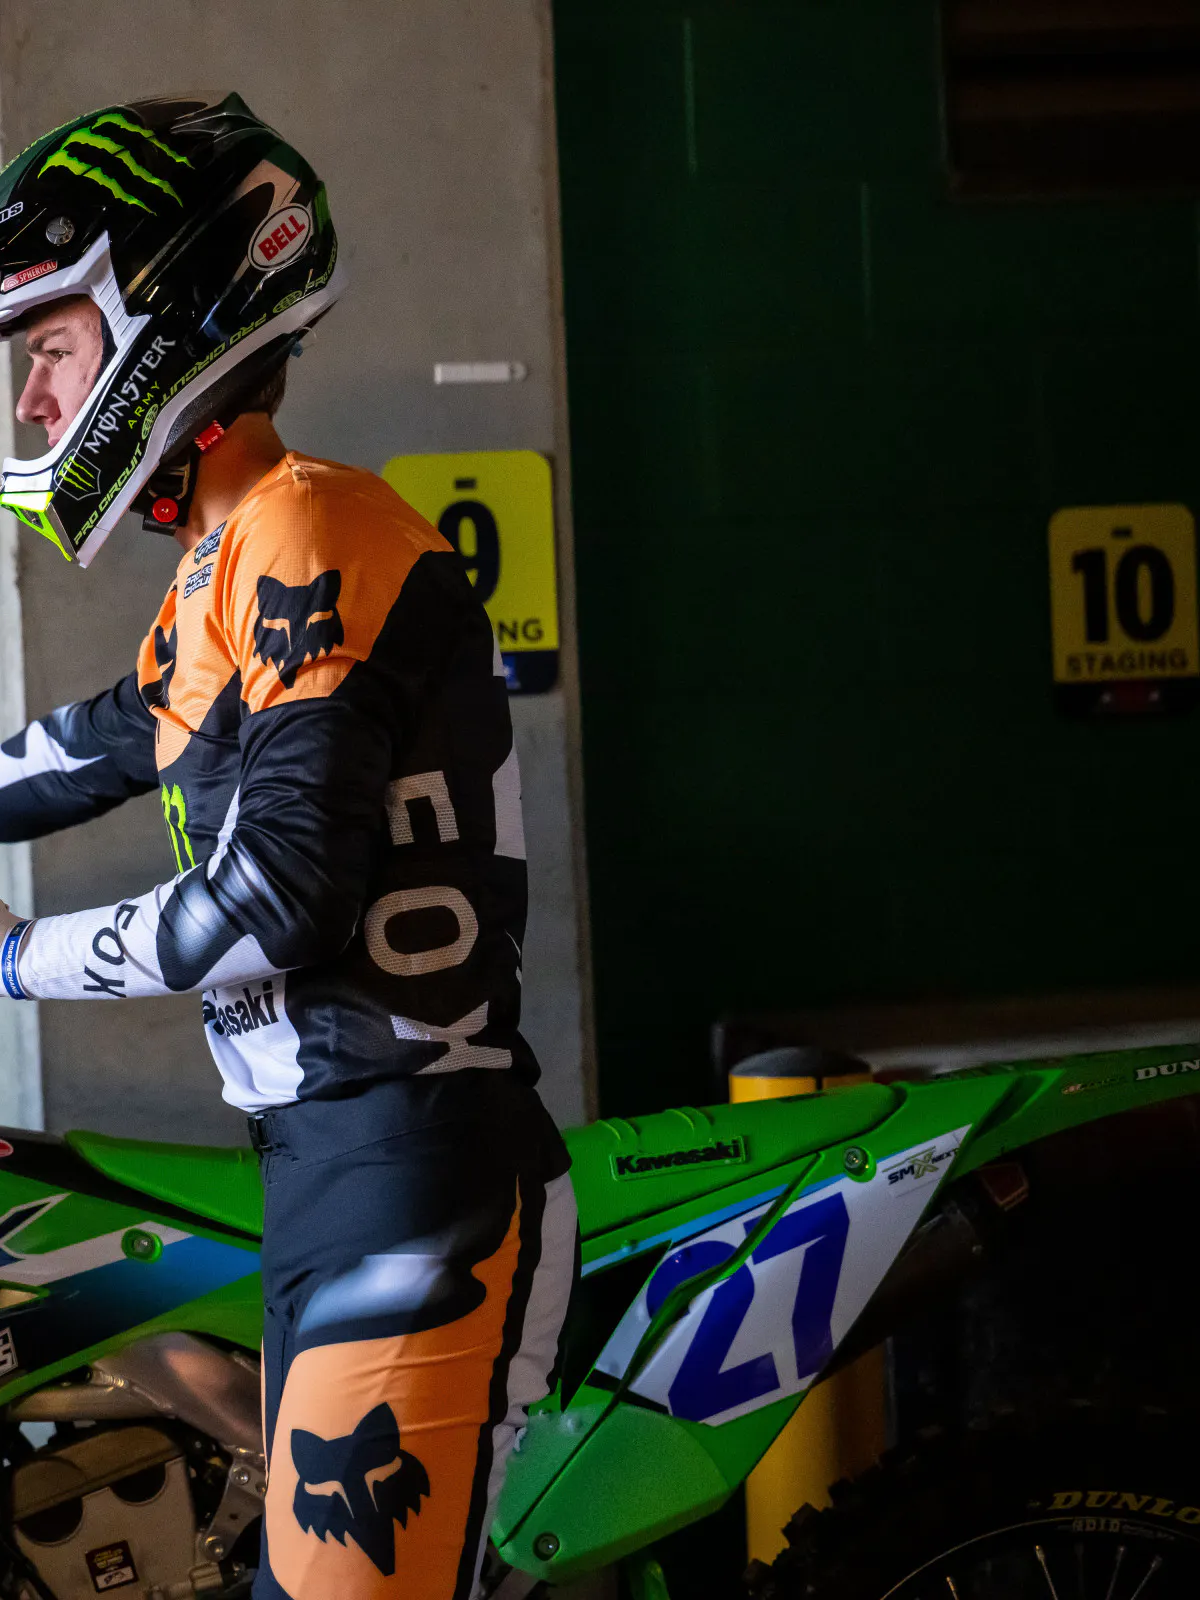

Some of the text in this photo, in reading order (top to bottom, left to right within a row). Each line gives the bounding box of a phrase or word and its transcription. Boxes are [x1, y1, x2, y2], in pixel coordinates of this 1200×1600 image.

[18, 261, 56, 283] SPHERICAL
[258, 214, 306, 262] BELL
[83, 335, 176, 455] MONSTER
[160, 312, 267, 407] PRO CIRCUIT
[127, 380, 161, 430] ARMY
[73, 442, 142, 546] PRO CIRCUIT
[437, 500, 500, 605] 9
[1071, 544, 1176, 645] 10
[1066, 649, 1189, 677] STAGING
[616, 1138, 743, 1176] Kawasaki
[887, 1151, 939, 1186] SMX
[646, 1191, 851, 1423] 27
